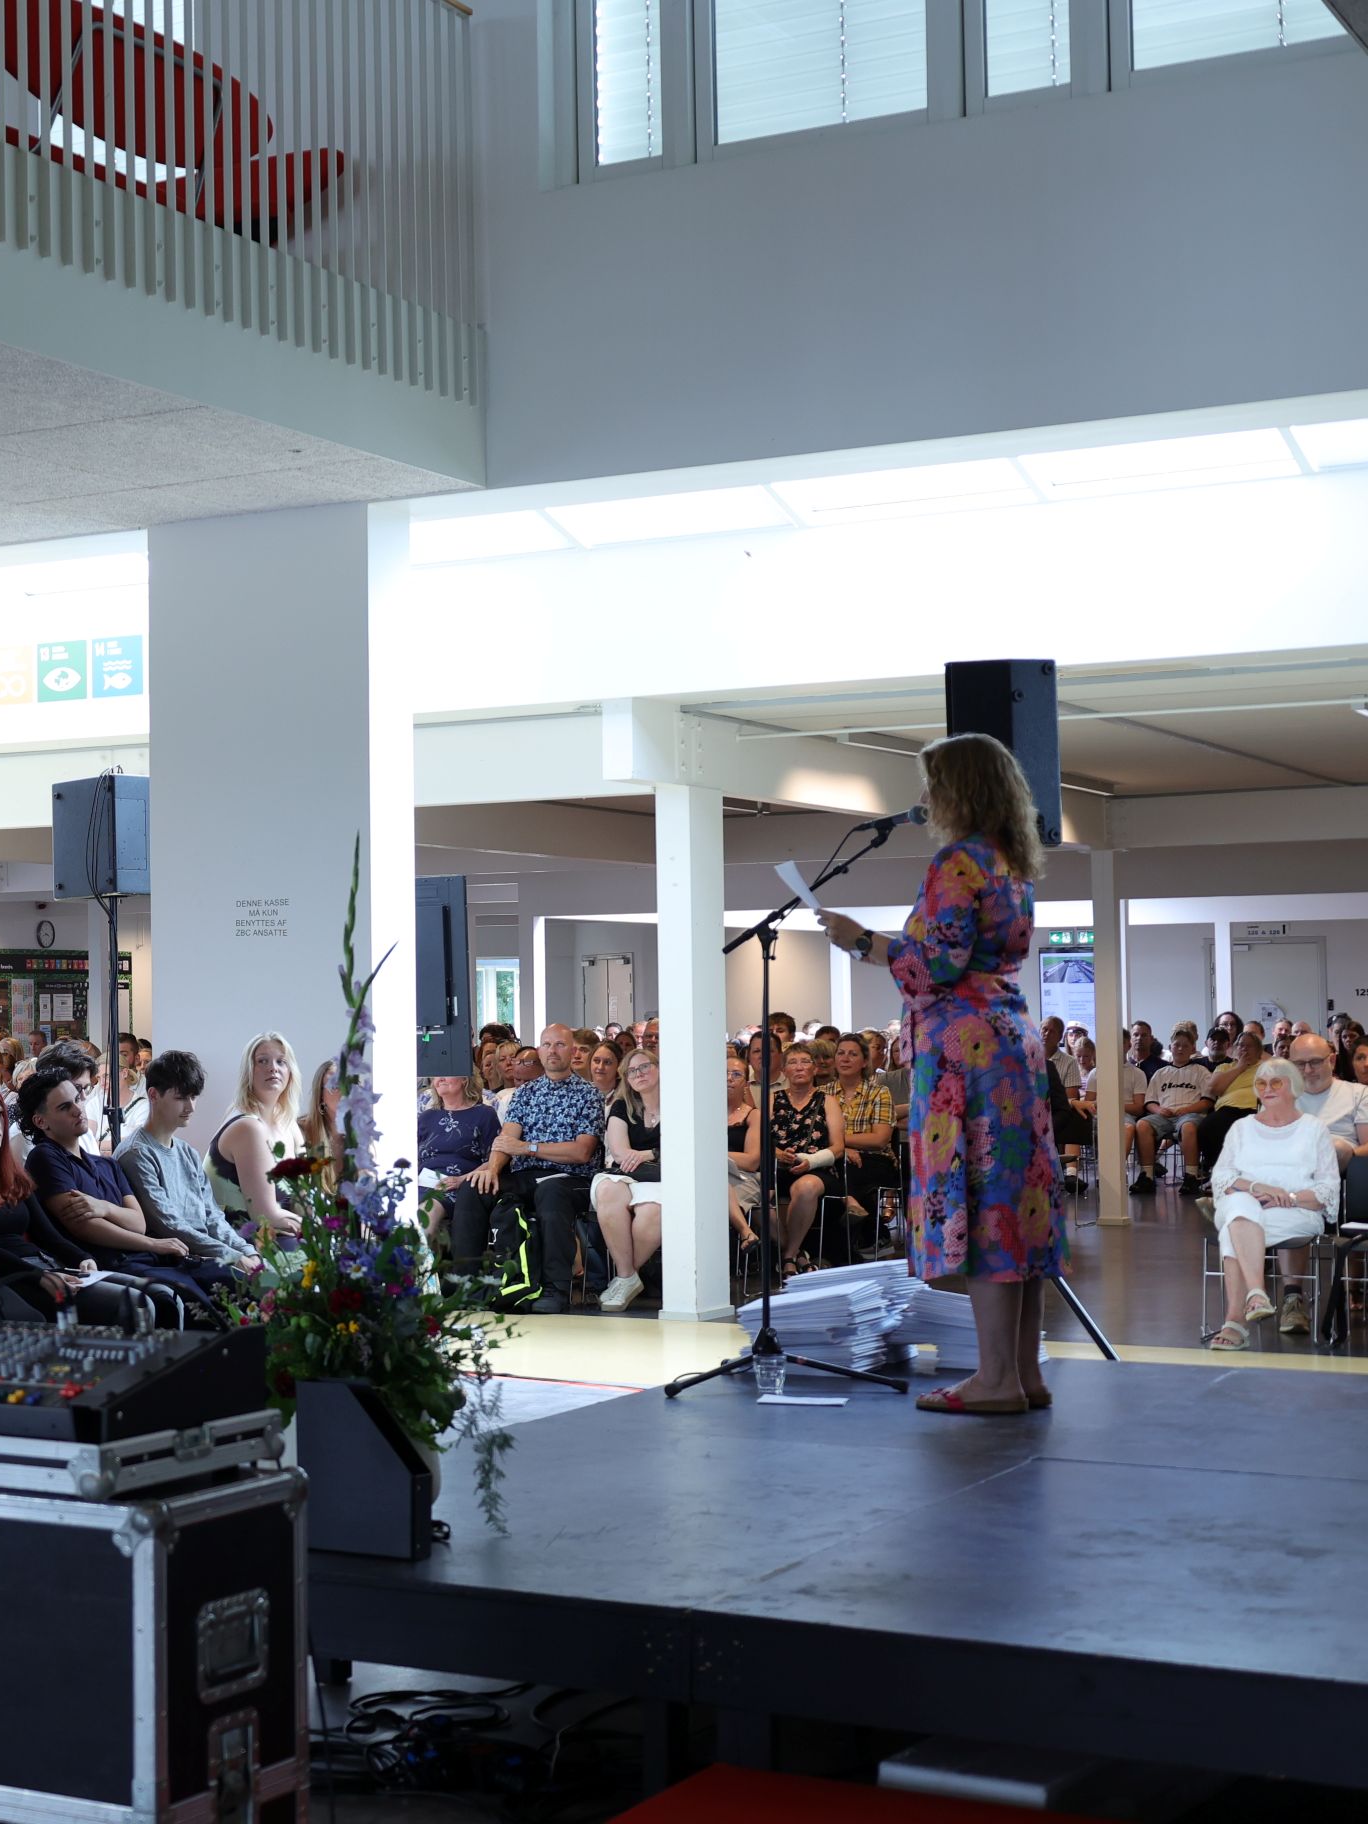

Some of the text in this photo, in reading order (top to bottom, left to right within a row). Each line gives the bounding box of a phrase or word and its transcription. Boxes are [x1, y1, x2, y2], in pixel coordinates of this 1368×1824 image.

[235, 898, 290, 908] DENNE KASSE
[248, 908, 279, 917] MÅ KUN
[235, 919, 287, 927] BENYTTES AF
[235, 929, 288, 937] ZBC ANSATTE
[1355, 988, 1368, 996] 12
